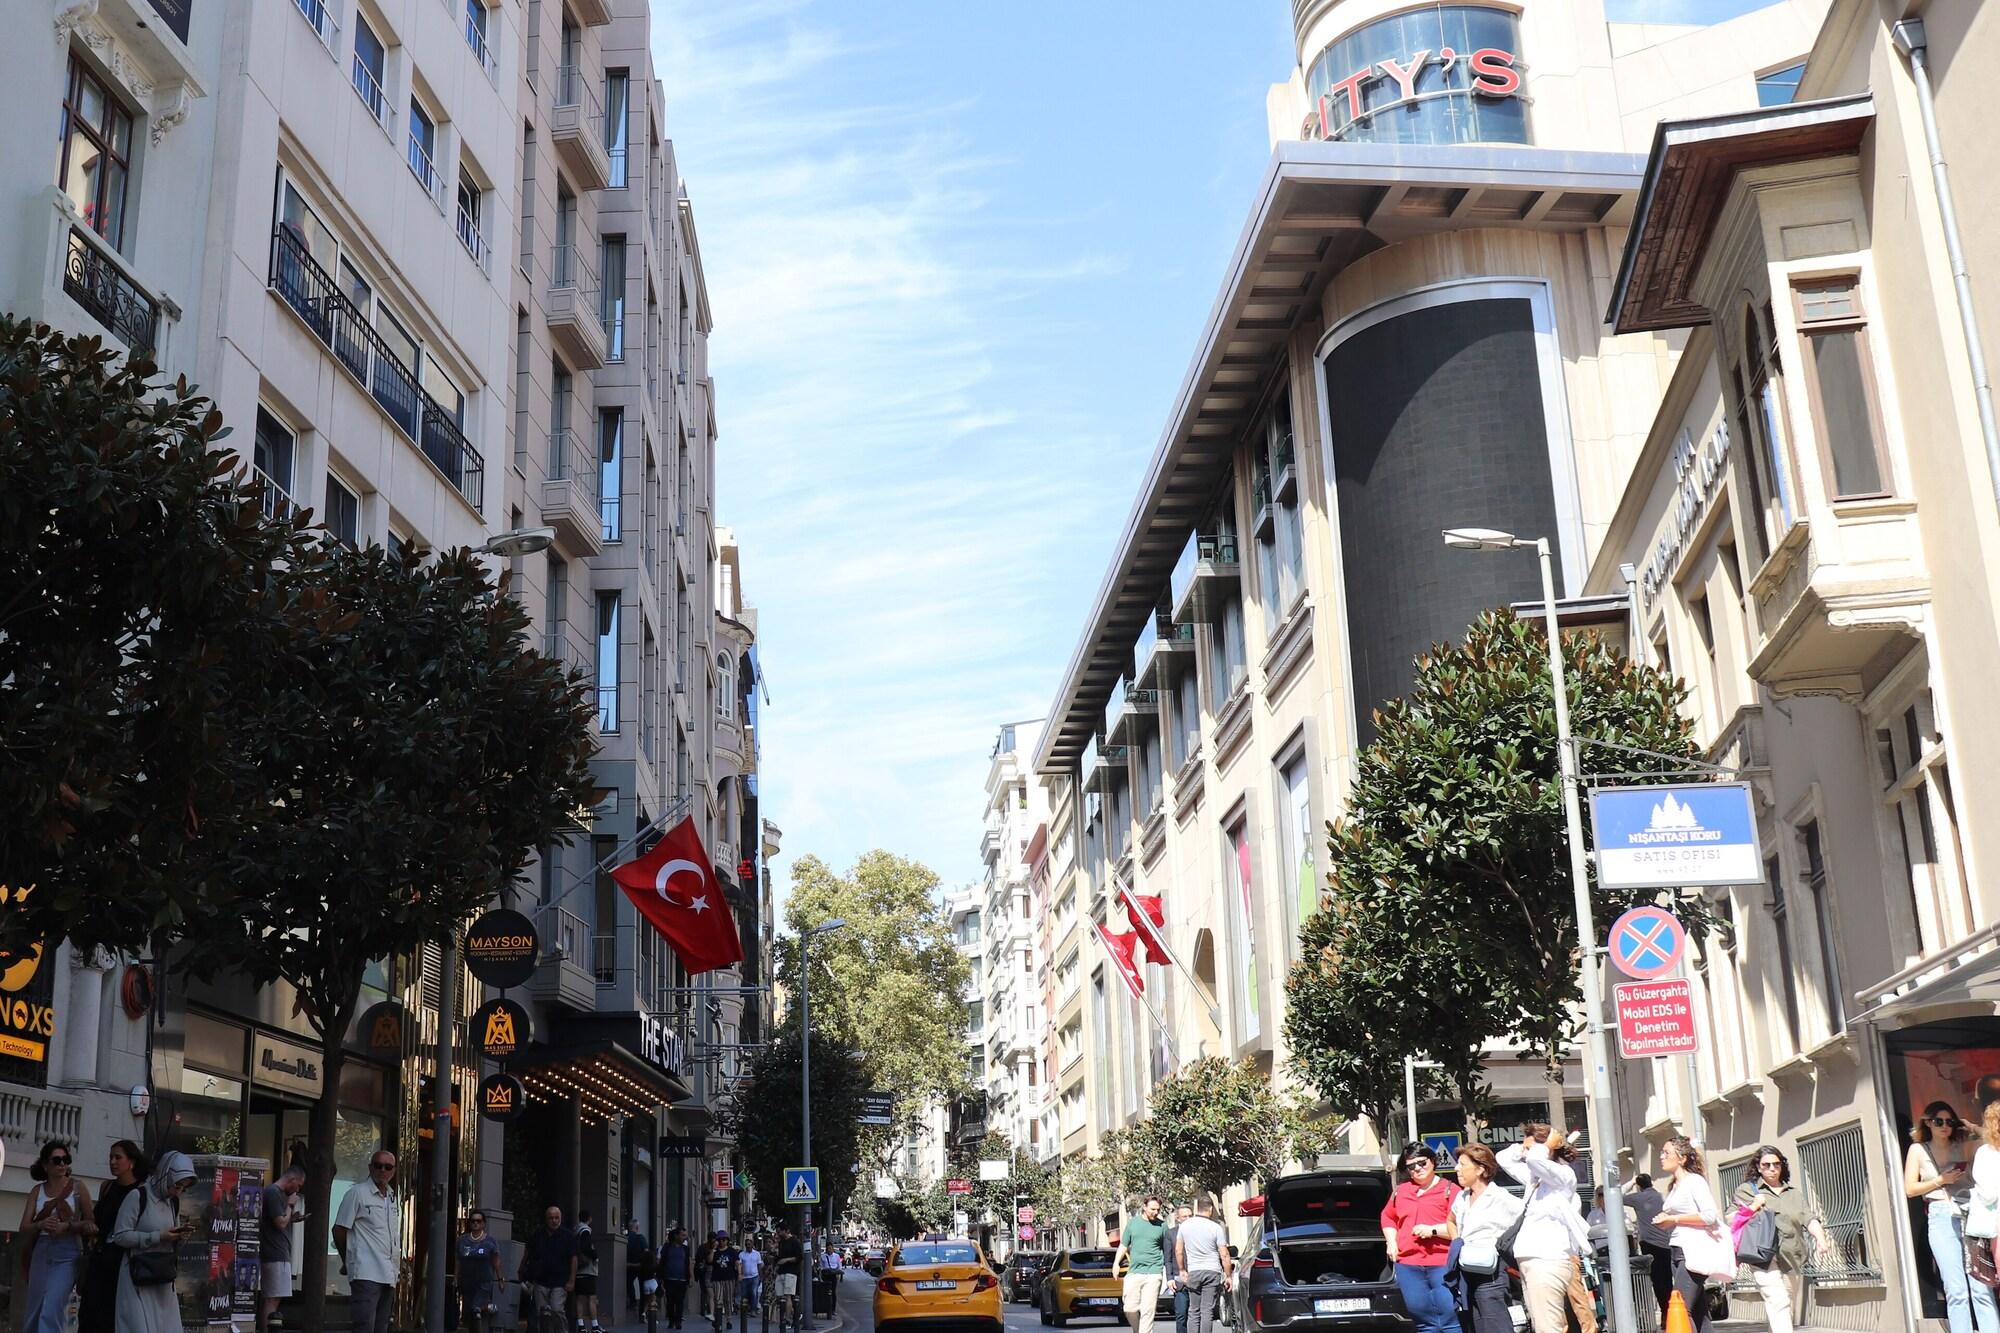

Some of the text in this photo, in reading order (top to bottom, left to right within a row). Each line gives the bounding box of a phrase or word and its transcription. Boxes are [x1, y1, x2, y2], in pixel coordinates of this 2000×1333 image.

[1690, 830, 1721, 841] KORU
[470, 936, 533, 948] MAYSON
[1617, 985, 1689, 1002] Bu Güzergahta
[1623, 1003, 1687, 1020] Mobil EDS ile
[1635, 1021, 1680, 1034] Denetim
[2, 1040, 34, 1057] Technology
[639, 1010, 684, 1077] THE STAY
[1623, 1033, 1694, 1052] Yapılmaktadır
[718, 1174, 729, 1186] E
